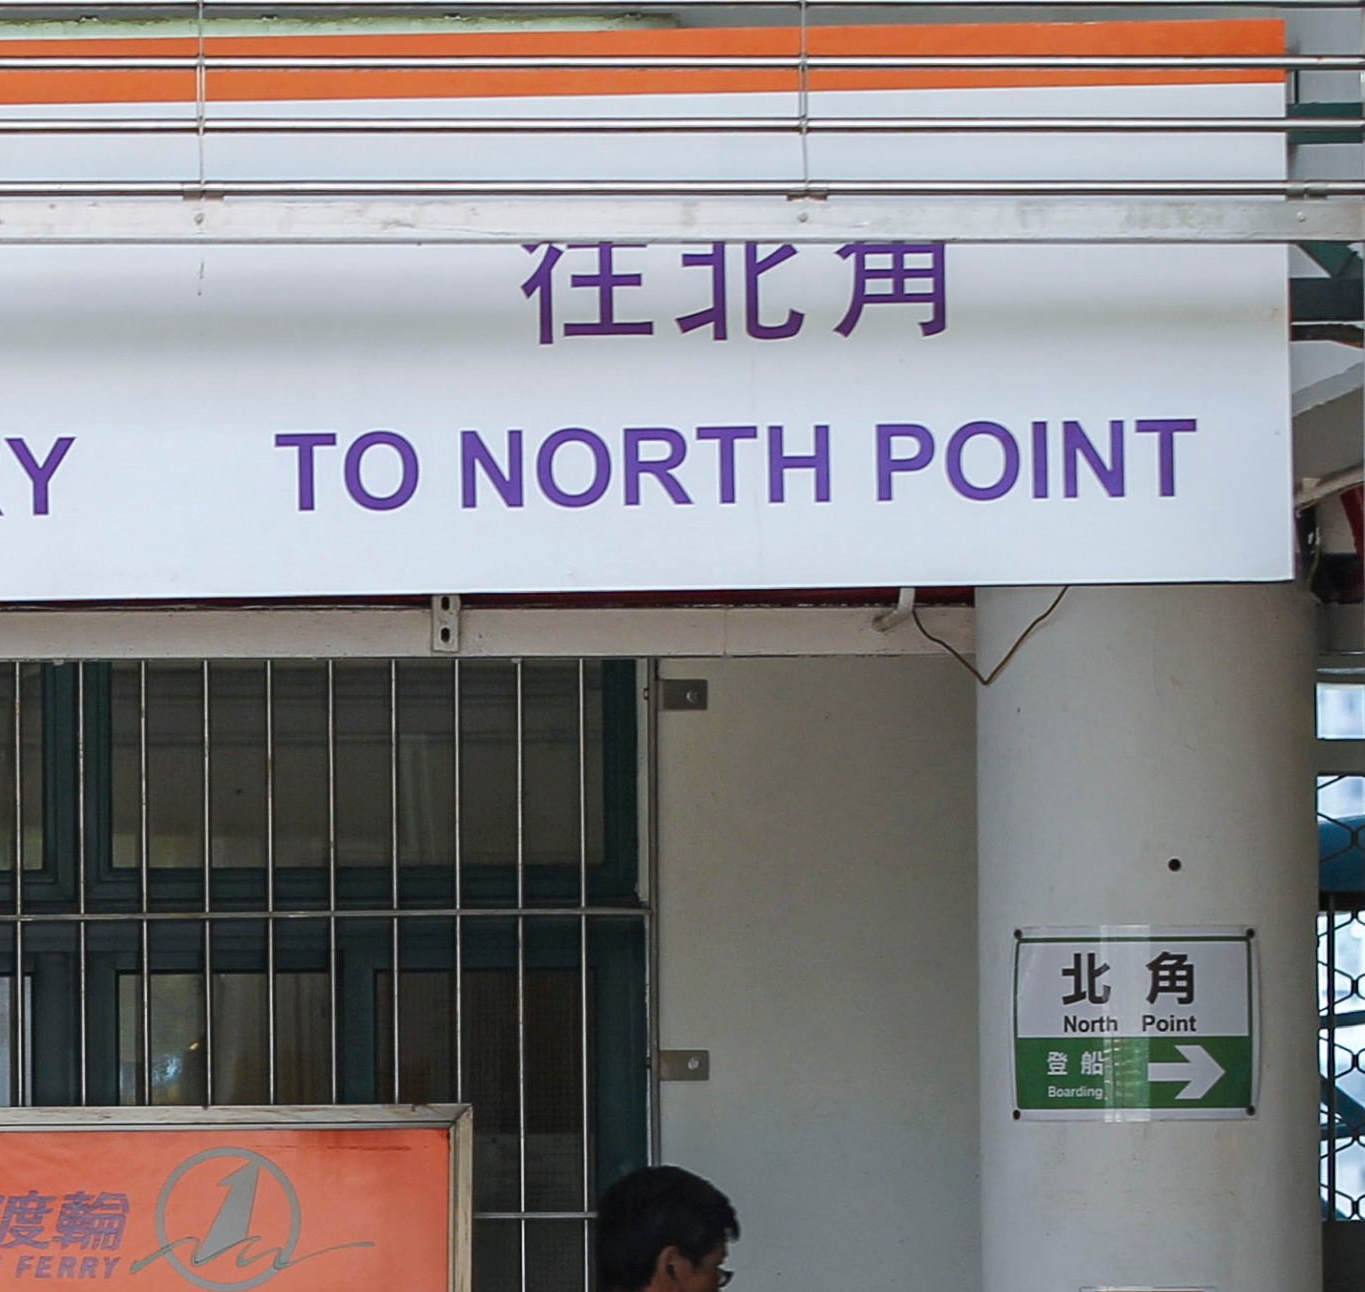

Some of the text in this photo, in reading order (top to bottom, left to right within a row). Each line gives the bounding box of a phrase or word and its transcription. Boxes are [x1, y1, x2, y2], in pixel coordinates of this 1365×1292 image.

[520, 242, 947, 345] 往北角
[275, 418, 1199, 513] TO NORTH POINT
[1061, 951, 1196, 1006] 北角
[1064, 1014, 1197, 1033] North Point
[1047, 1051, 1105, 1076] 登船
[1047, 1086, 1104, 1099] Boarding
[15, 1253, 123, 1280] FERRY
